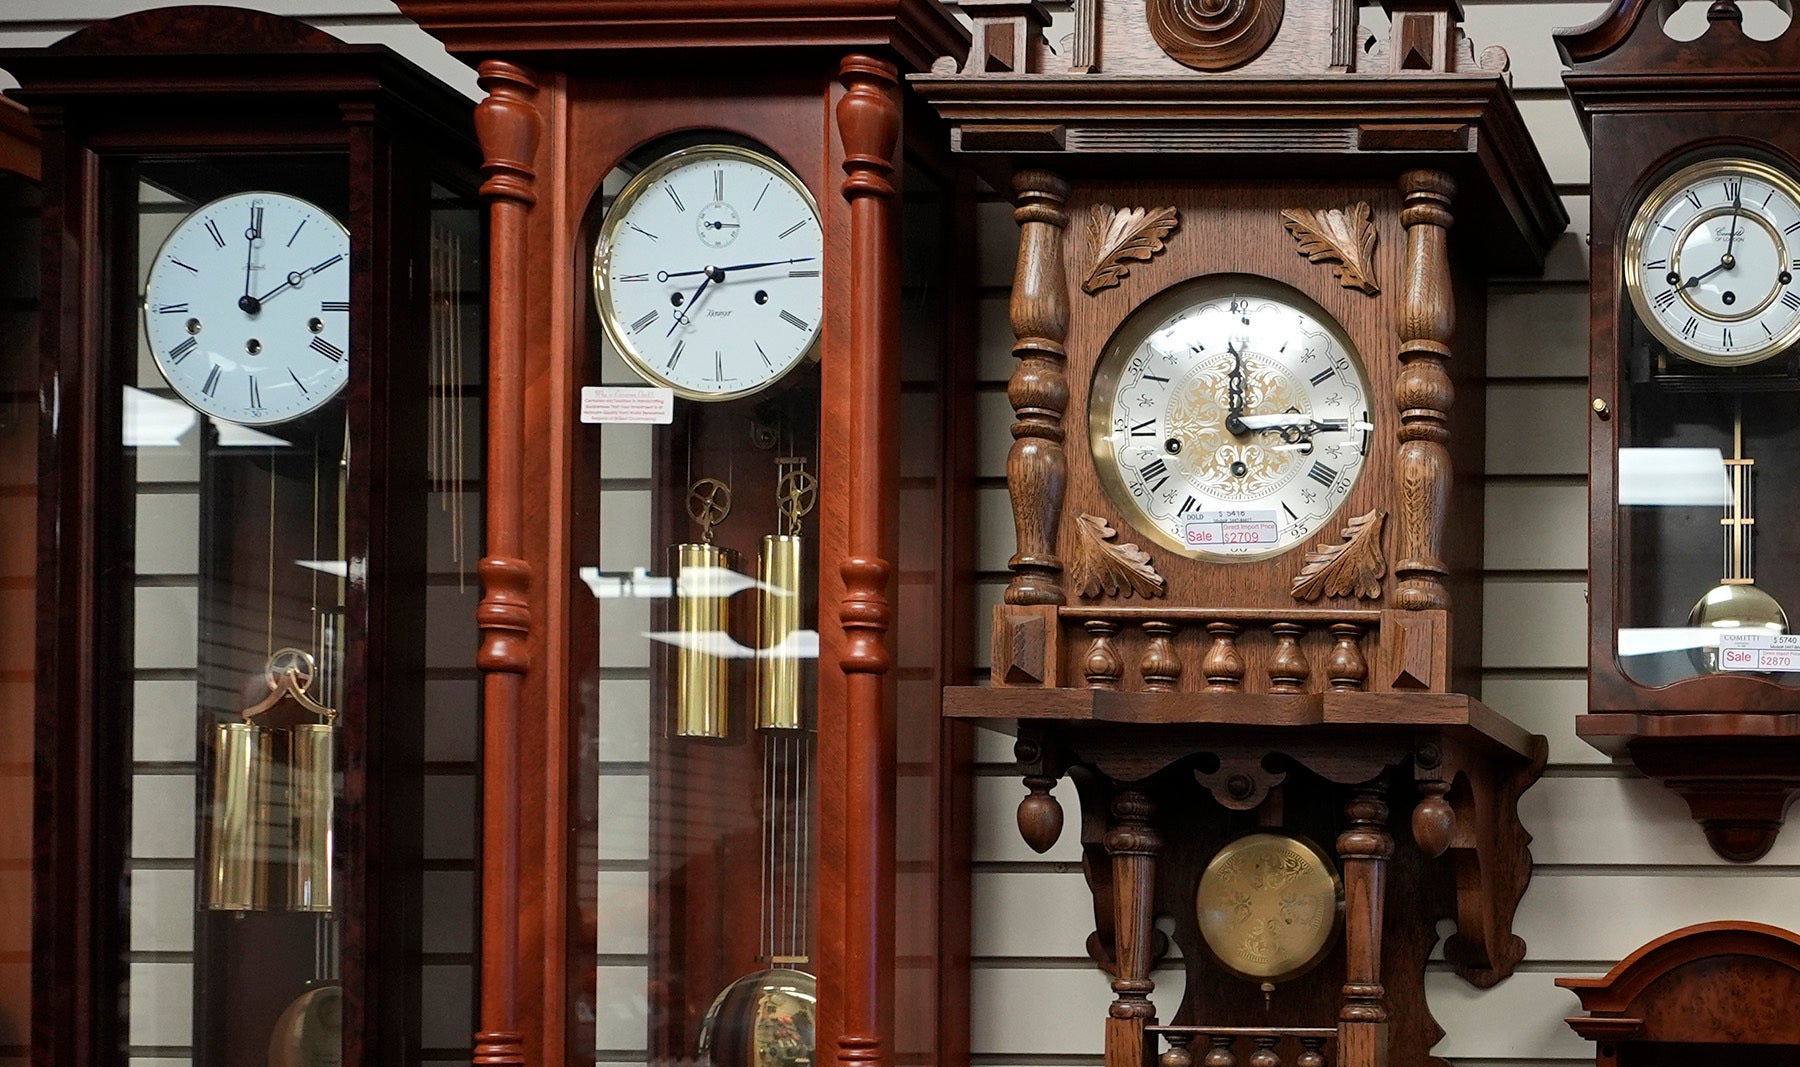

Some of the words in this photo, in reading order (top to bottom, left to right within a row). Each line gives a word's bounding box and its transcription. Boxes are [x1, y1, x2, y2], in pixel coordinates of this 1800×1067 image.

[1310, 367, 1336, 387] II
[1188, 531, 1212, 541] Sale
[1225, 532, 1258, 543] $2709
[1726, 651, 1751, 661] Sale
[1761, 657, 1790, 666] $2870
